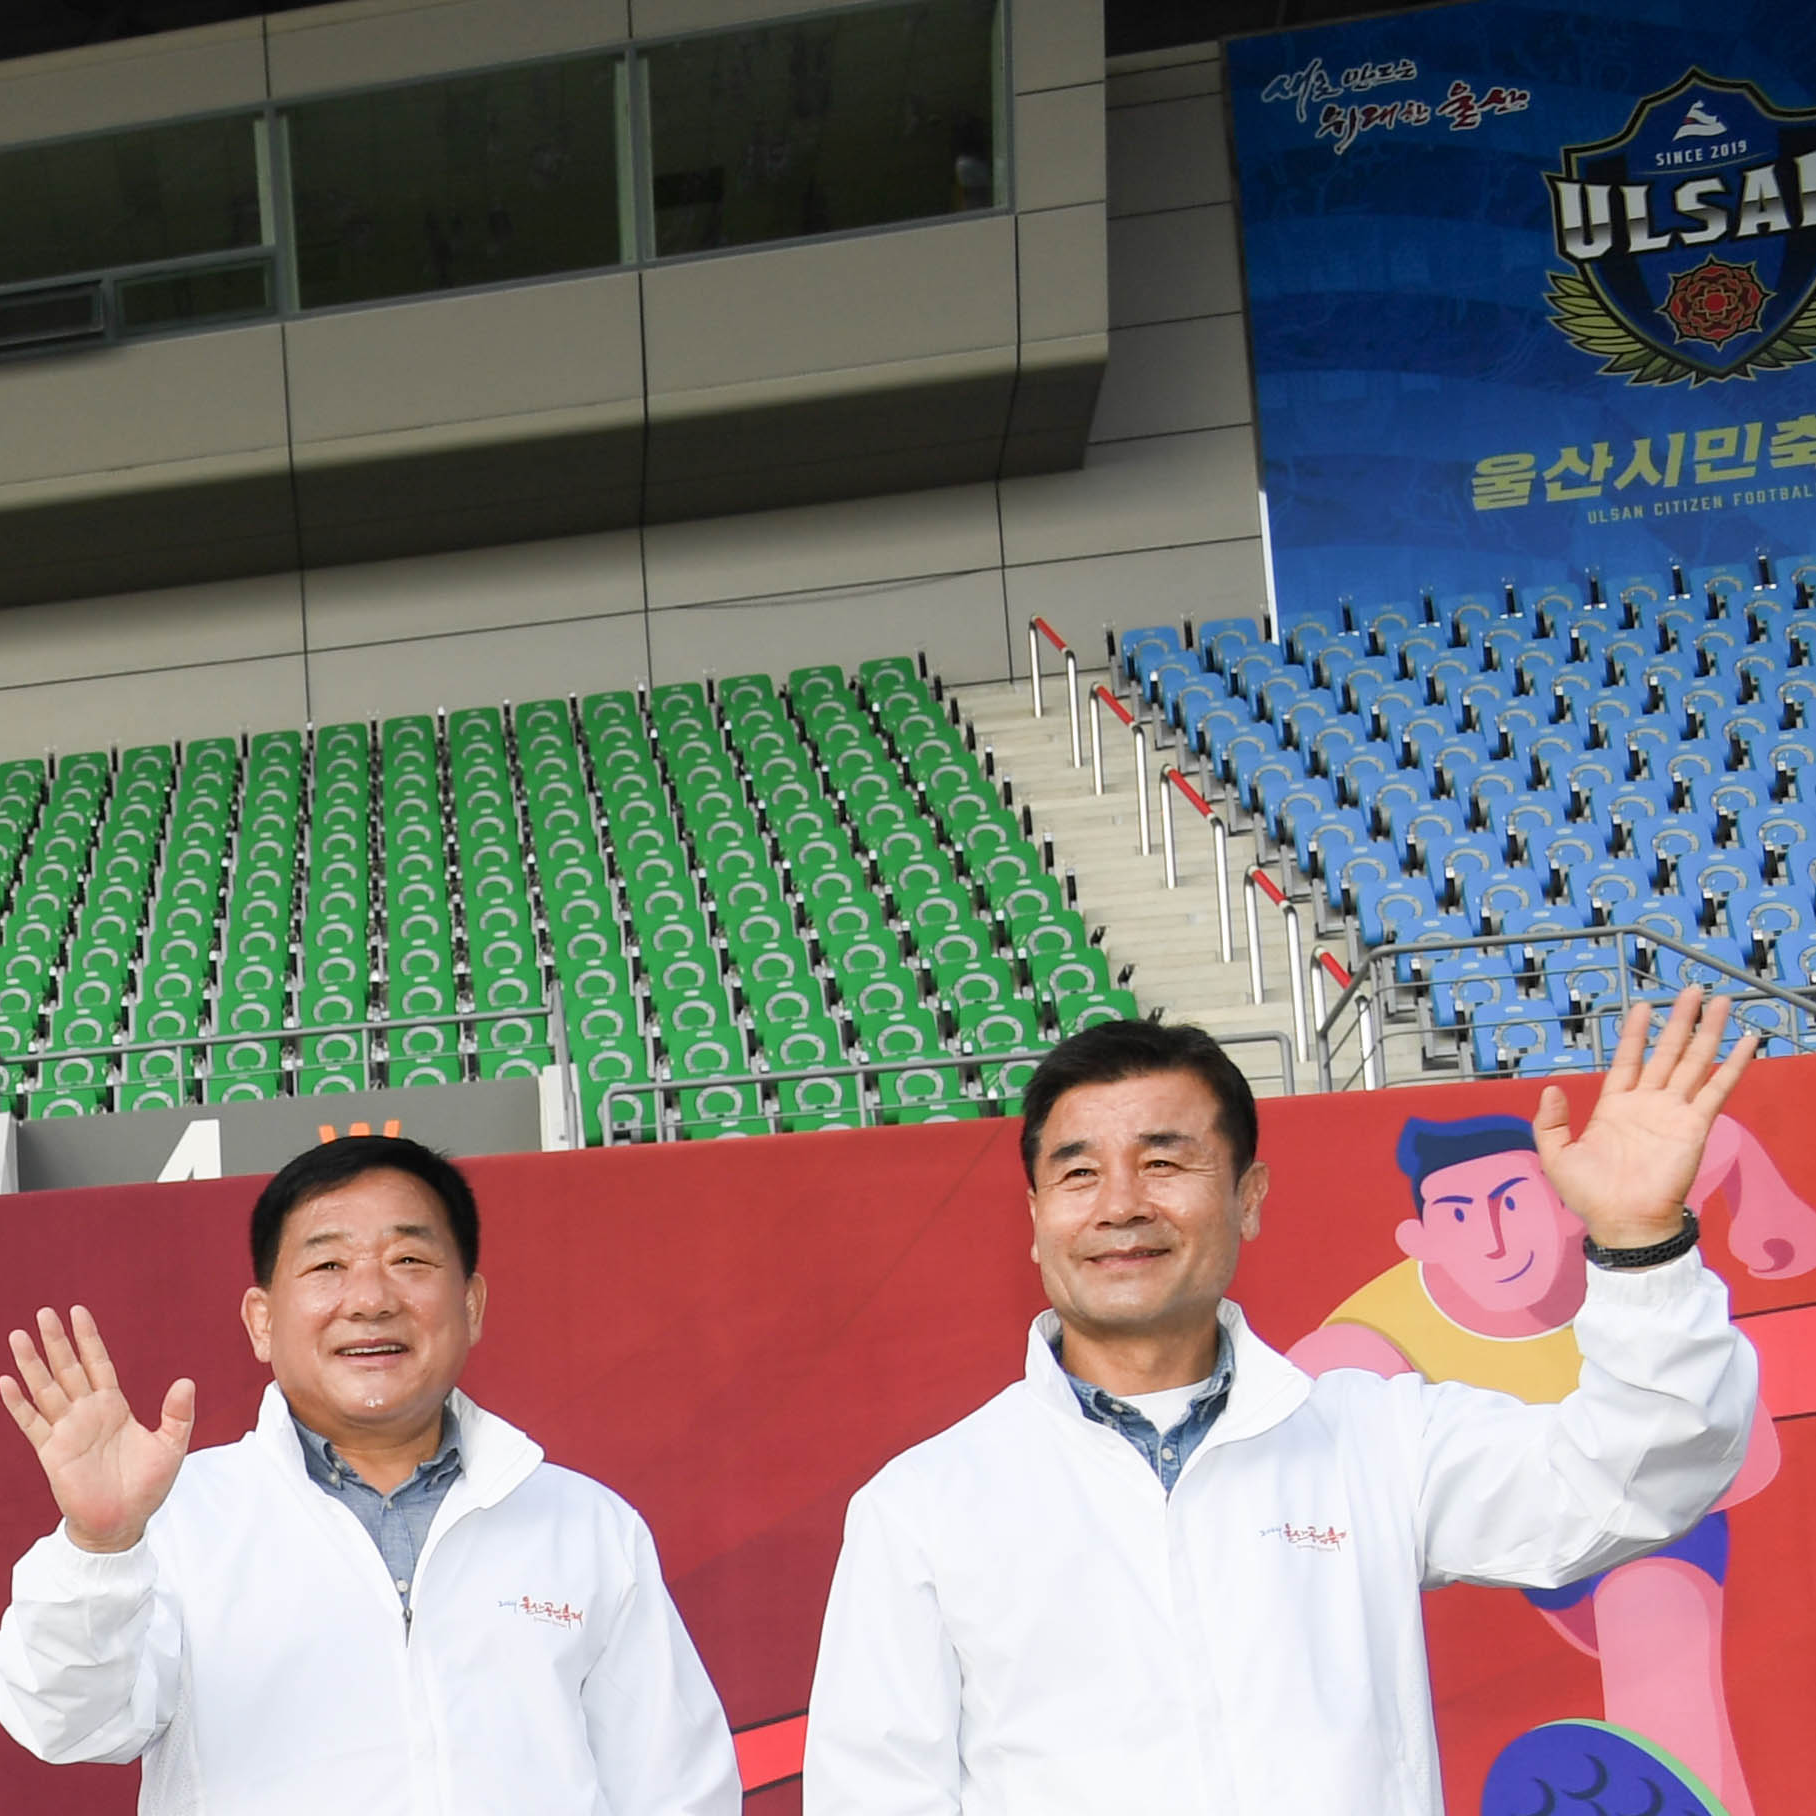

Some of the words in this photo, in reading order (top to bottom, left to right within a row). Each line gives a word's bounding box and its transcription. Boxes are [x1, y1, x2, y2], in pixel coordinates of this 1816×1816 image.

[1655, 150, 1703, 167] SINCE
[1710, 139, 1748, 159] 2019
[1587, 506, 1644, 525] ULSAN
[1654, 495, 1723, 517] CITIZEN
[1732, 484, 1816, 507] FOOTBAL
